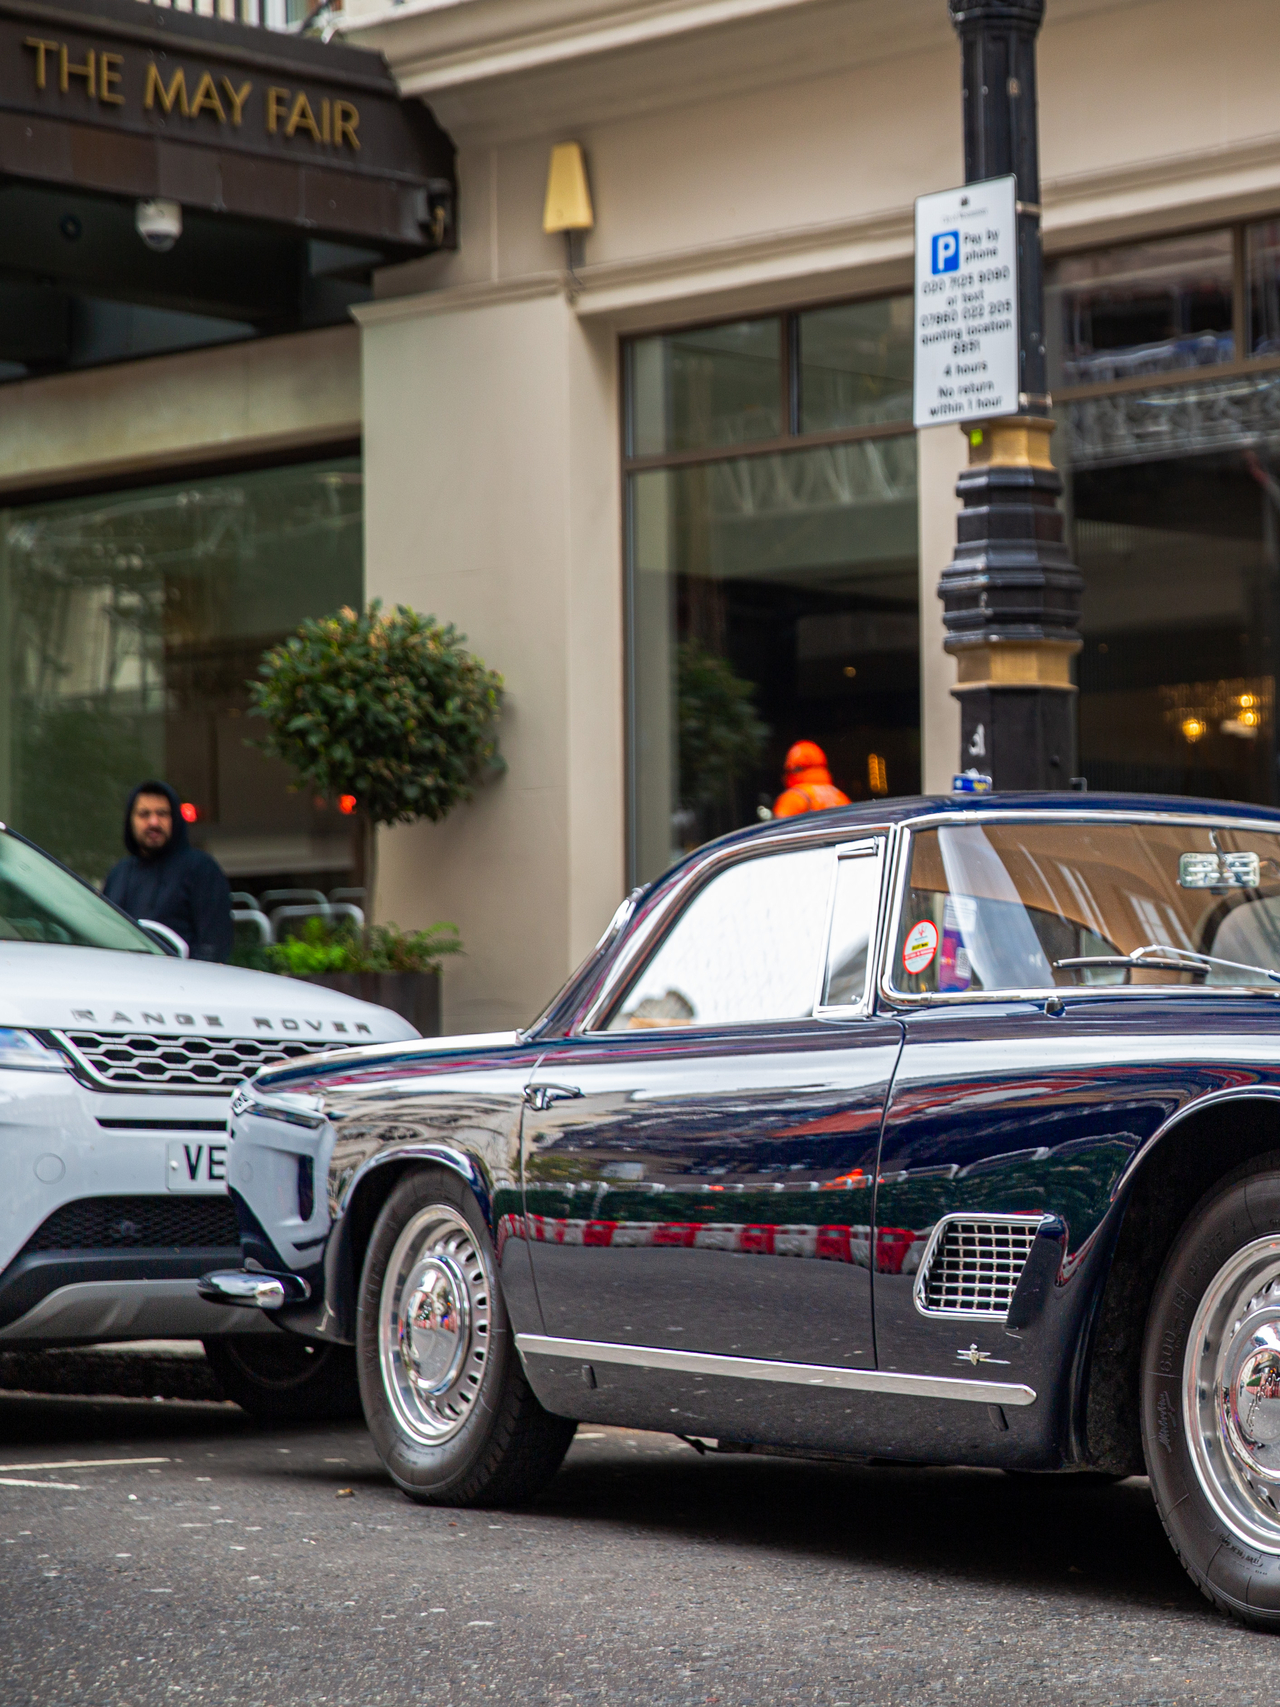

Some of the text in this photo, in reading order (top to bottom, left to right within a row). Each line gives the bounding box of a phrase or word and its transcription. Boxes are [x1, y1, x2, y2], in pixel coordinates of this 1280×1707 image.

[23, 37, 362, 150] THE MAY FAIR
[964, 230, 998, 245] Pay by
[938, 234, 956, 270] P
[965, 248, 997, 264] phone
[947, 291, 983, 306] or text
[922, 320, 1011, 346] quoting location
[944, 362, 987, 376] 4 hours
[939, 382, 993, 398] No return
[931, 402, 963, 416] within
[977, 397, 1002, 409] hour
[72, 1009, 372, 1034] RANGE ROVER
